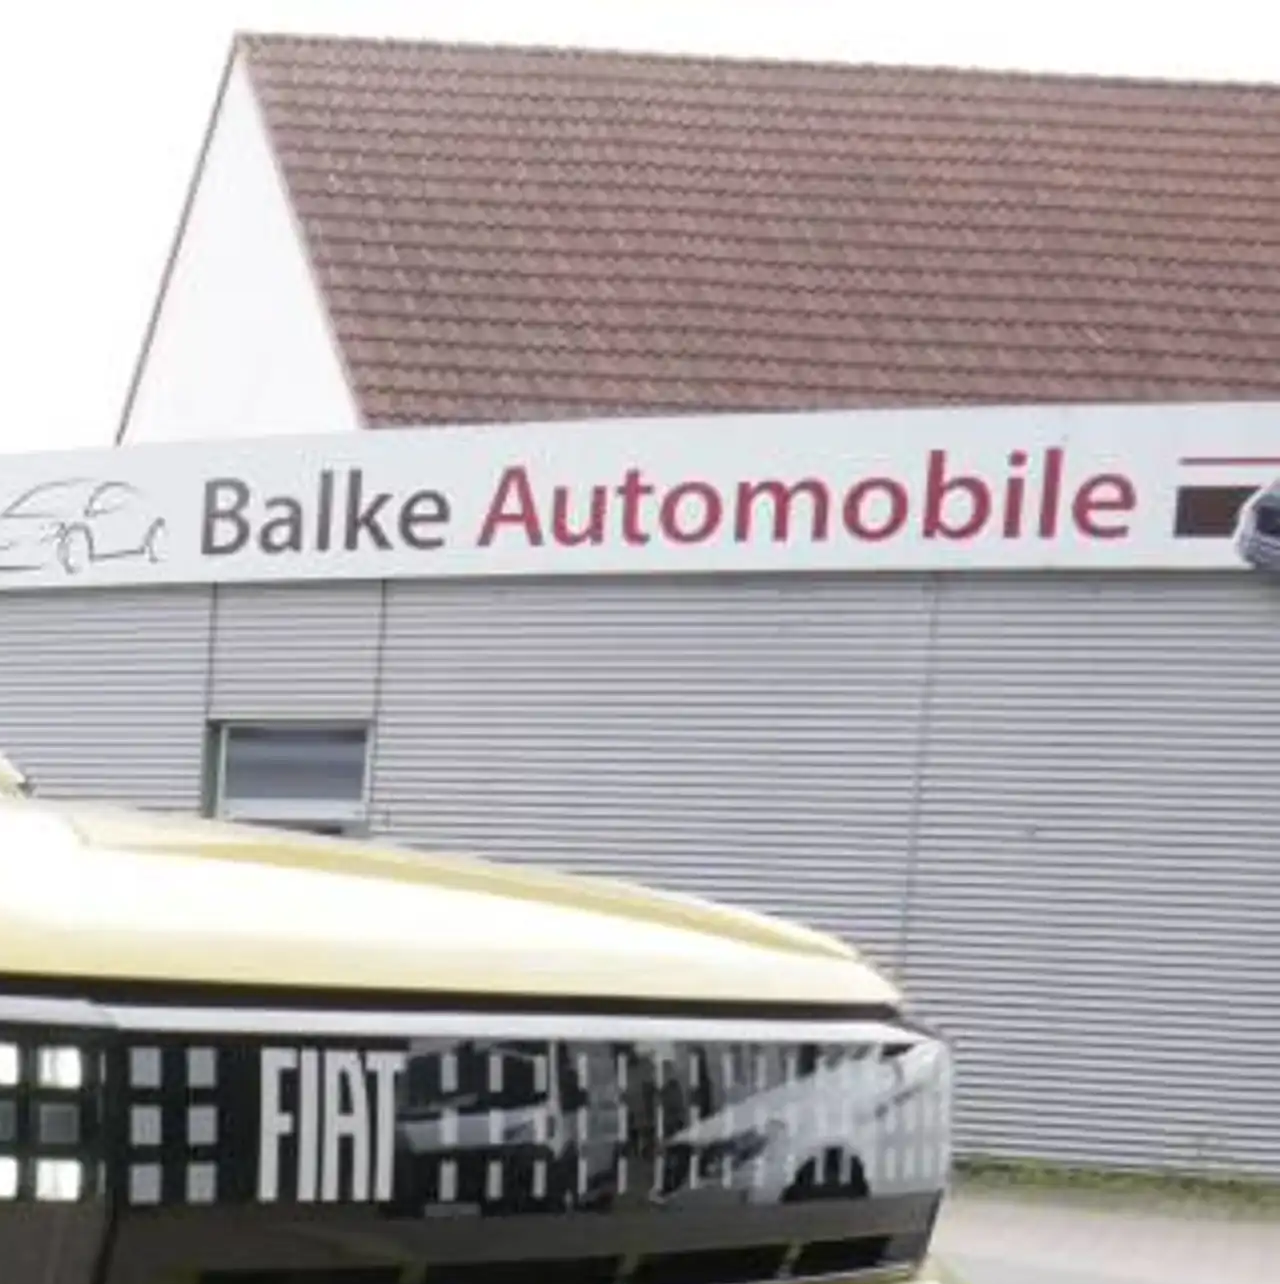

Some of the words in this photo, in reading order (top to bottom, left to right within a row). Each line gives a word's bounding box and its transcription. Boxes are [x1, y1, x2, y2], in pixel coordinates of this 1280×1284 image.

[200, 467, 452, 556] Balke
[476, 446, 1138, 548] Automobile
[257, 1046, 407, 1203] FIAT
